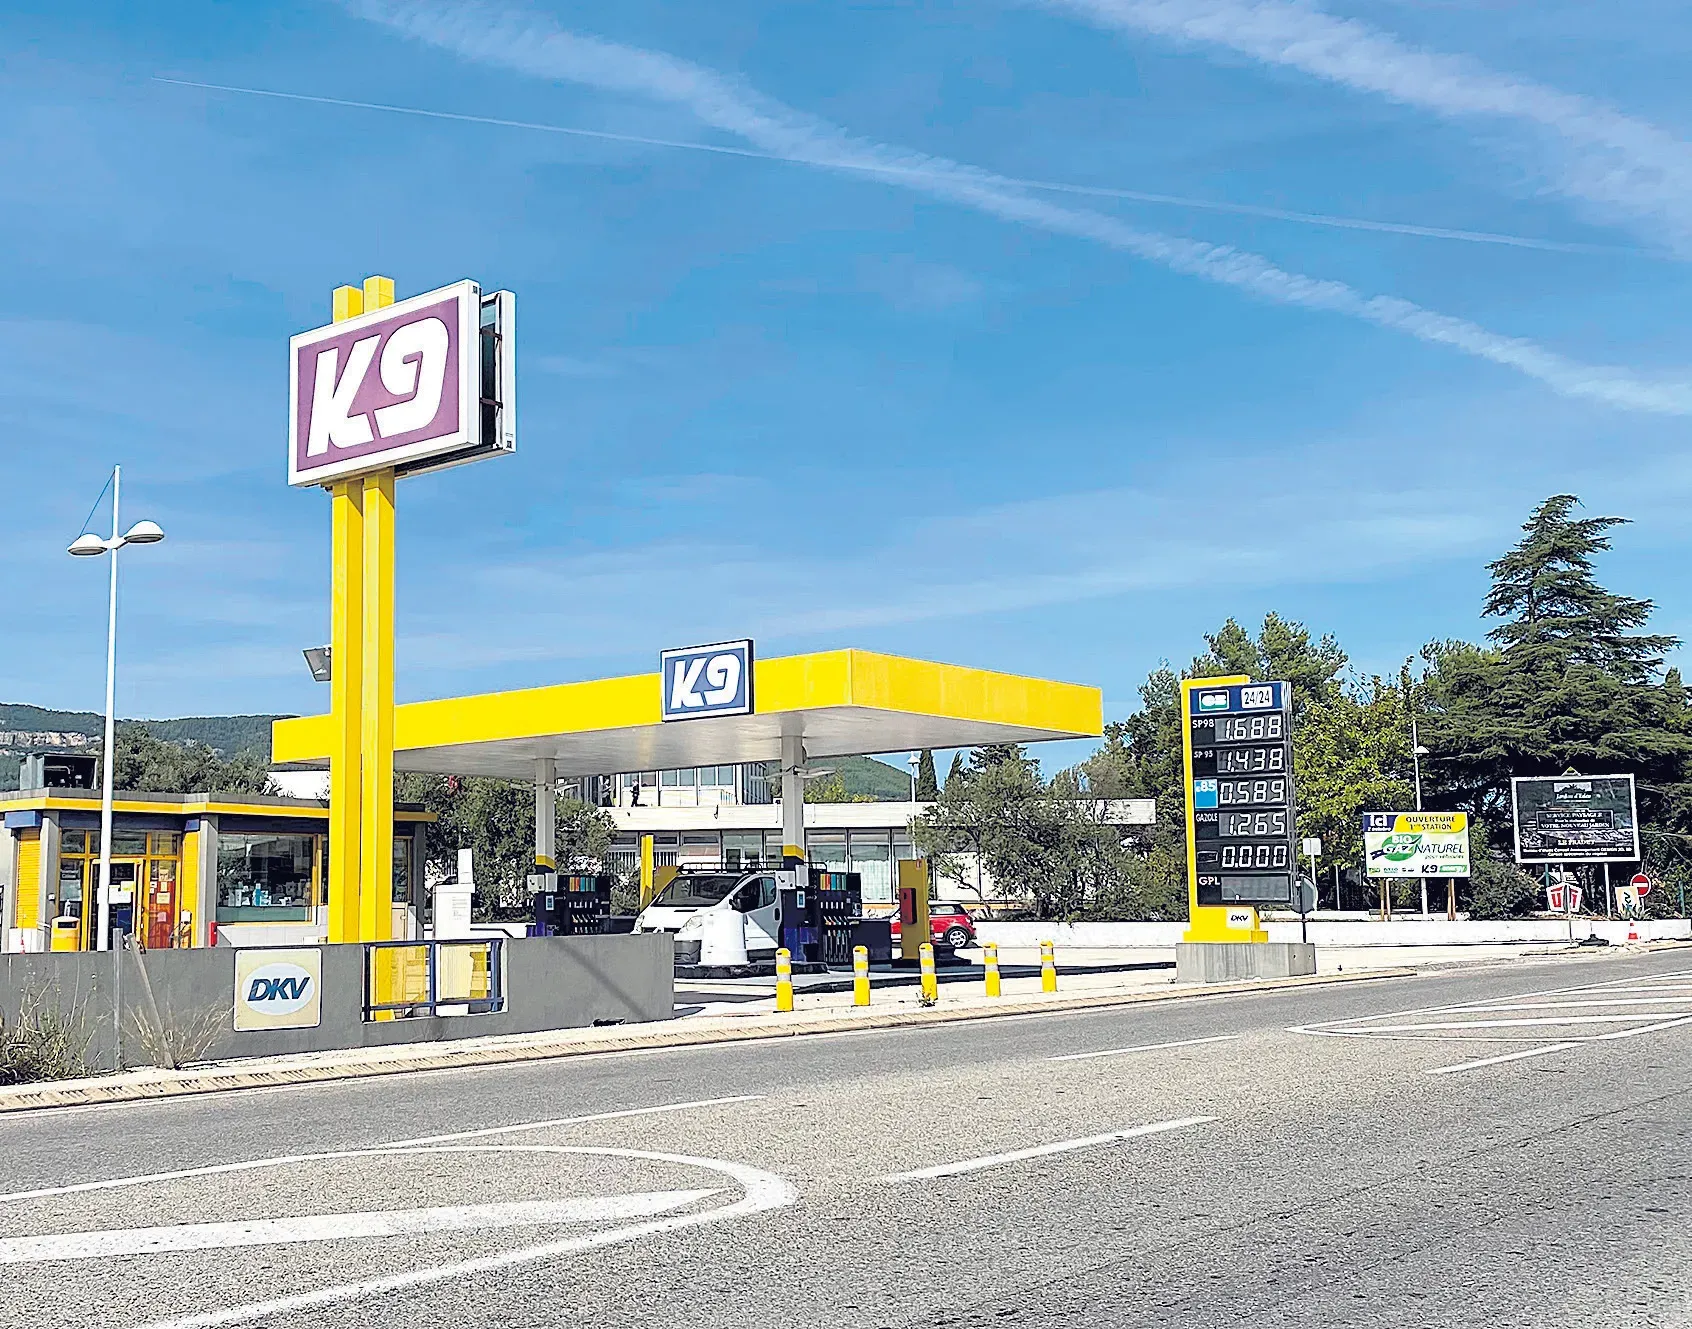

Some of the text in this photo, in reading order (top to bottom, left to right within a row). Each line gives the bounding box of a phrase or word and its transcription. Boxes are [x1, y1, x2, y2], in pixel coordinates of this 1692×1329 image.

[306, 317, 450, 458] K9
[670, 654, 741, 709] K9
[1244, 689, 1270, 705] 24/24
[1192, 719, 1215, 729] SP98
[1219, 781, 1284, 804] 0.589
[1196, 813, 1218, 822] GAZOLE
[1392, 836, 1413, 844] BIO
[1383, 843, 1413, 854] GAZ
[1414, 843, 1465, 854] NATUREL
[1222, 845, 1287, 868] 0.000
[1421, 864, 1438, 874] K9
[1198, 876, 1221, 885] GPL
[248, 977, 310, 1001] DKV
